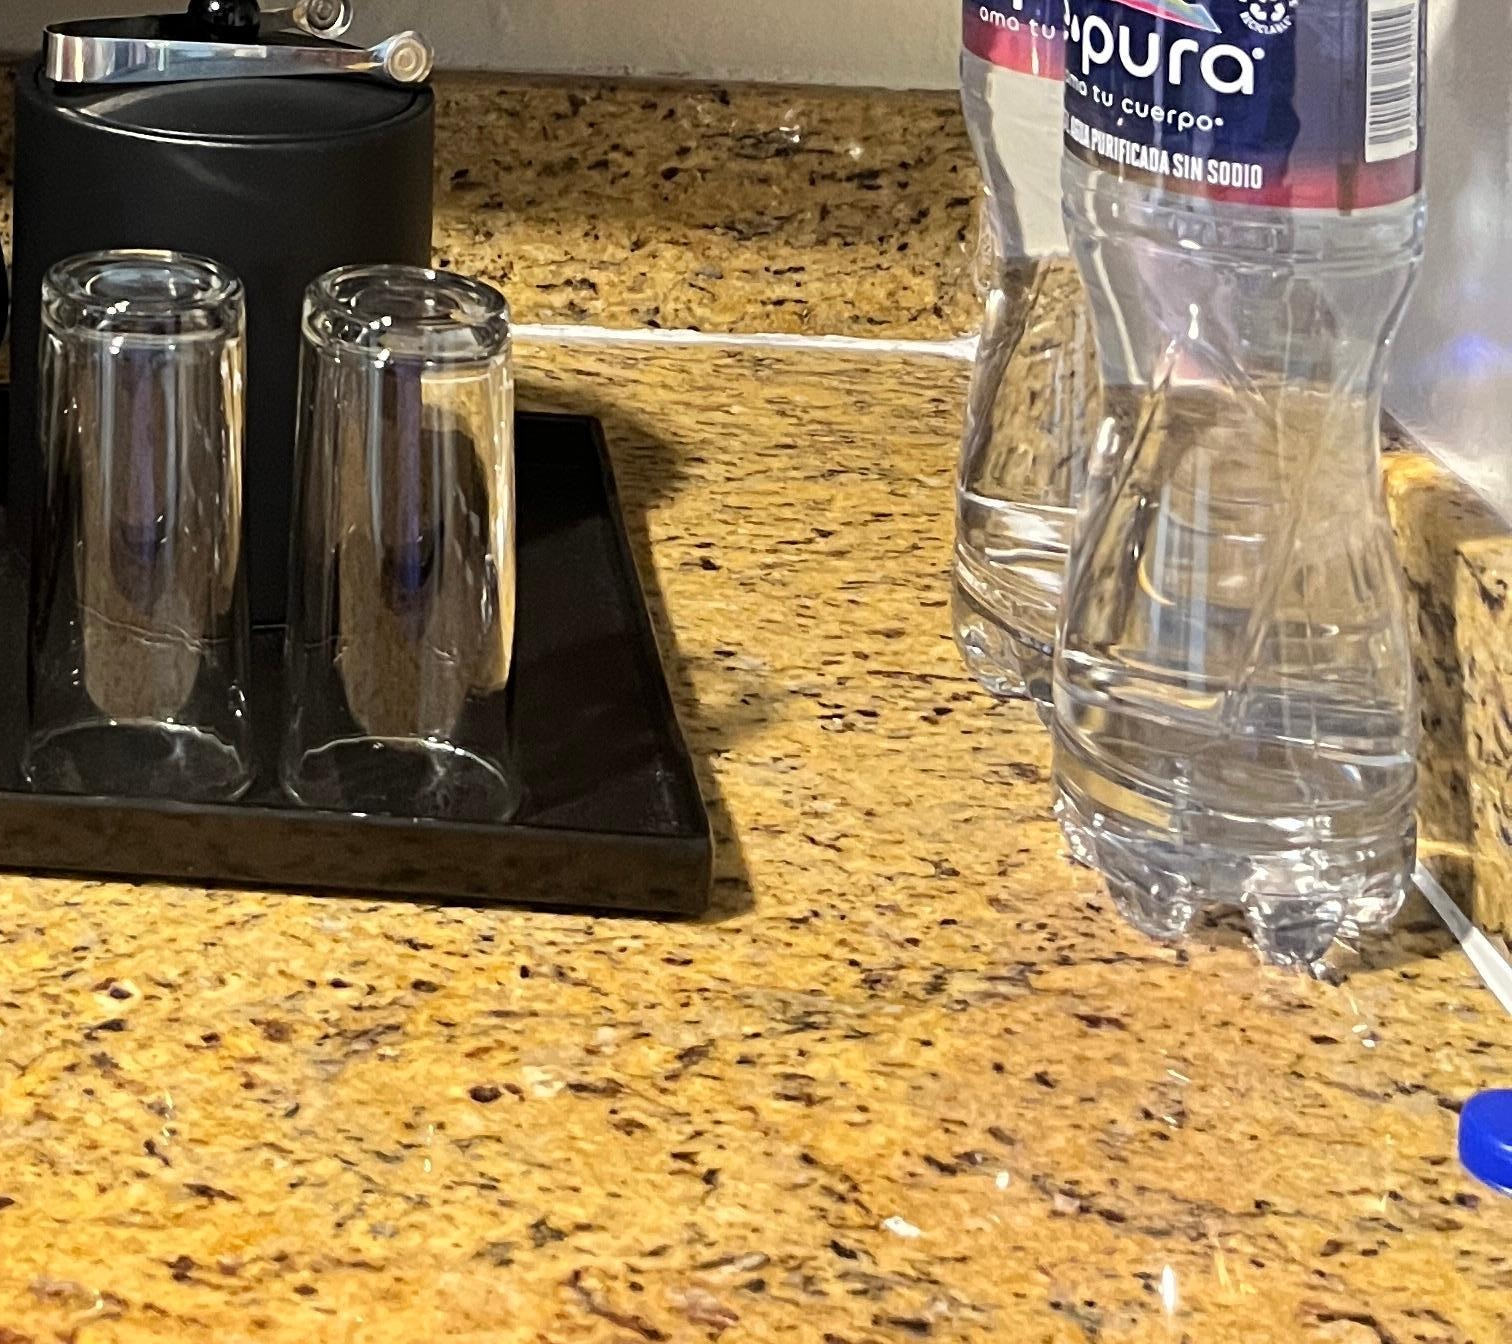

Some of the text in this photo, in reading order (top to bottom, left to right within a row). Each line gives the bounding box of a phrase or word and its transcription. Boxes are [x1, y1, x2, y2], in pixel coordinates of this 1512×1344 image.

[979, 5, 1056, 41] ama tu
[1092, 85, 1114, 107] tu
[1121, 96, 1213, 133] cuerpo
[1090, 127, 1171, 176] PURIFICADA
[1171, 152, 1205, 183] SIN
[1206, 158, 1264, 190] SODIO
